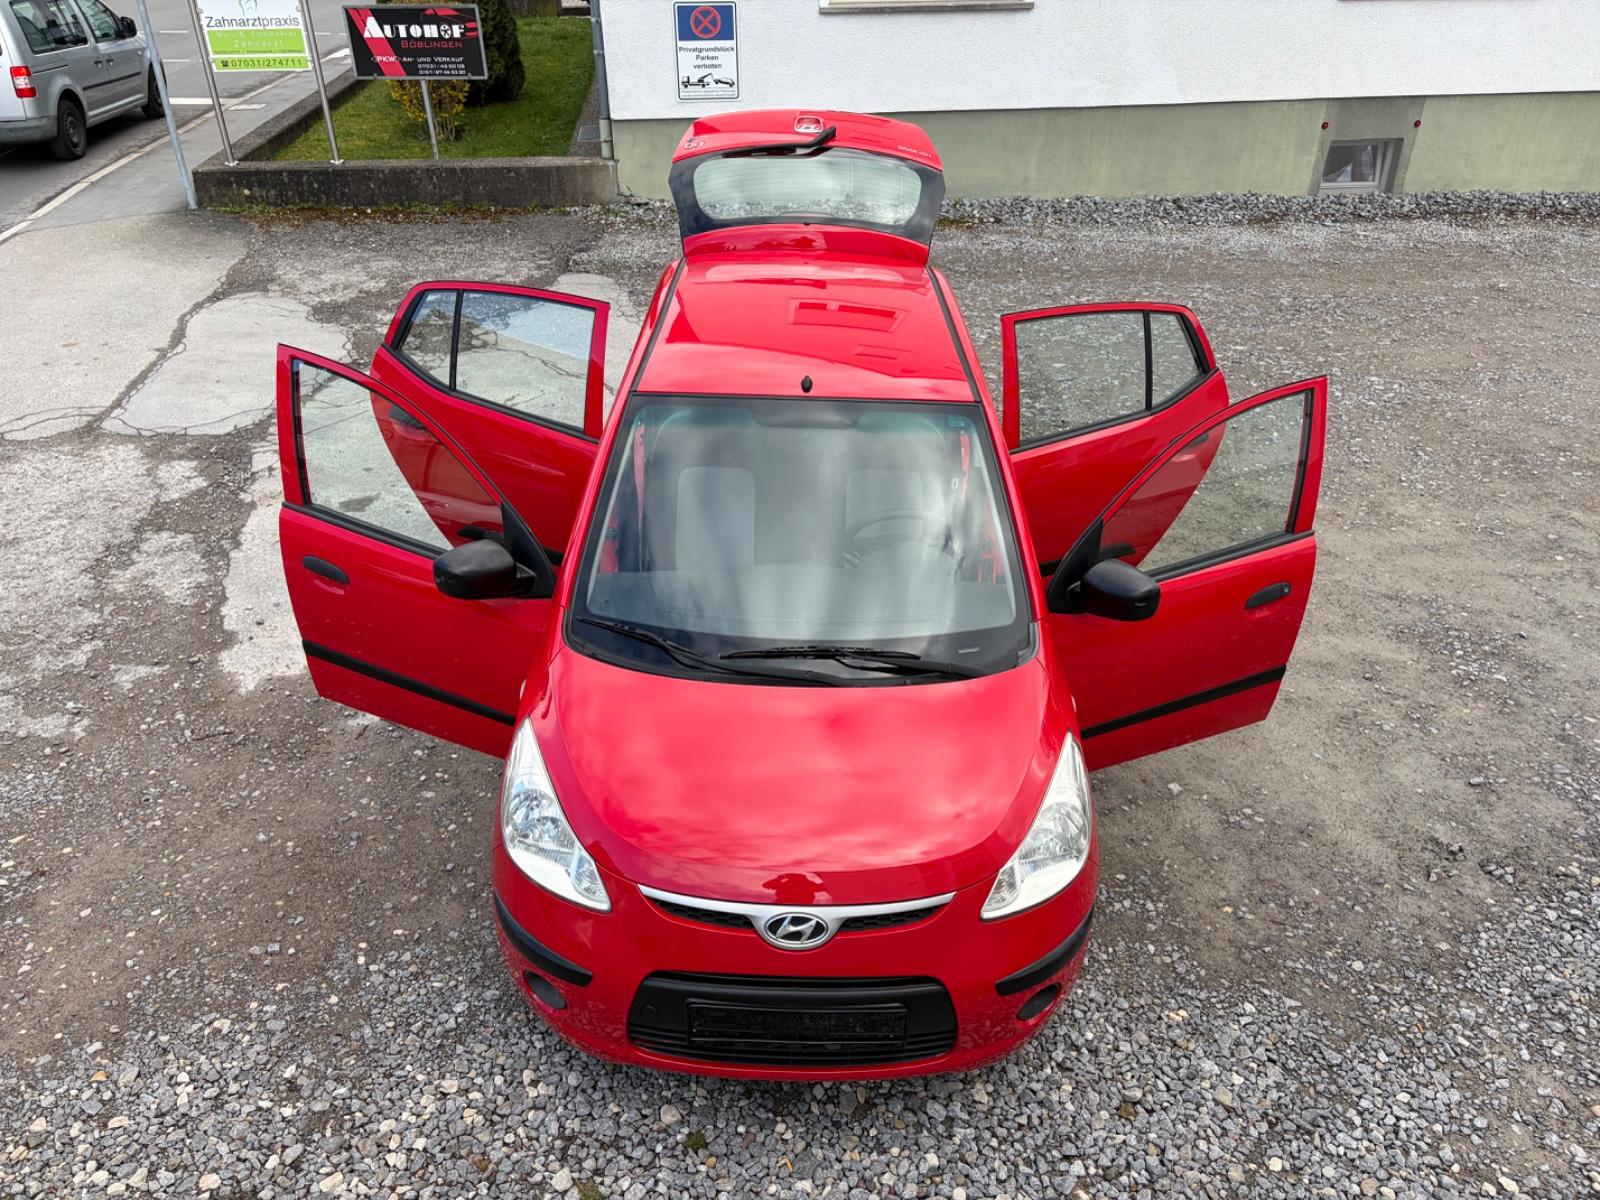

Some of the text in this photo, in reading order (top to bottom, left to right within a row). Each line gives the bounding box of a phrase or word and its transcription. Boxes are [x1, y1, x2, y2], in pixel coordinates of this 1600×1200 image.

[205, 15, 300, 29] Zahnarztpraxis
[363, 16, 465, 39] AUTOHOF
[679, 45, 735, 53] Privatgrundstück
[231, 58, 302, 67] 07031/274711
